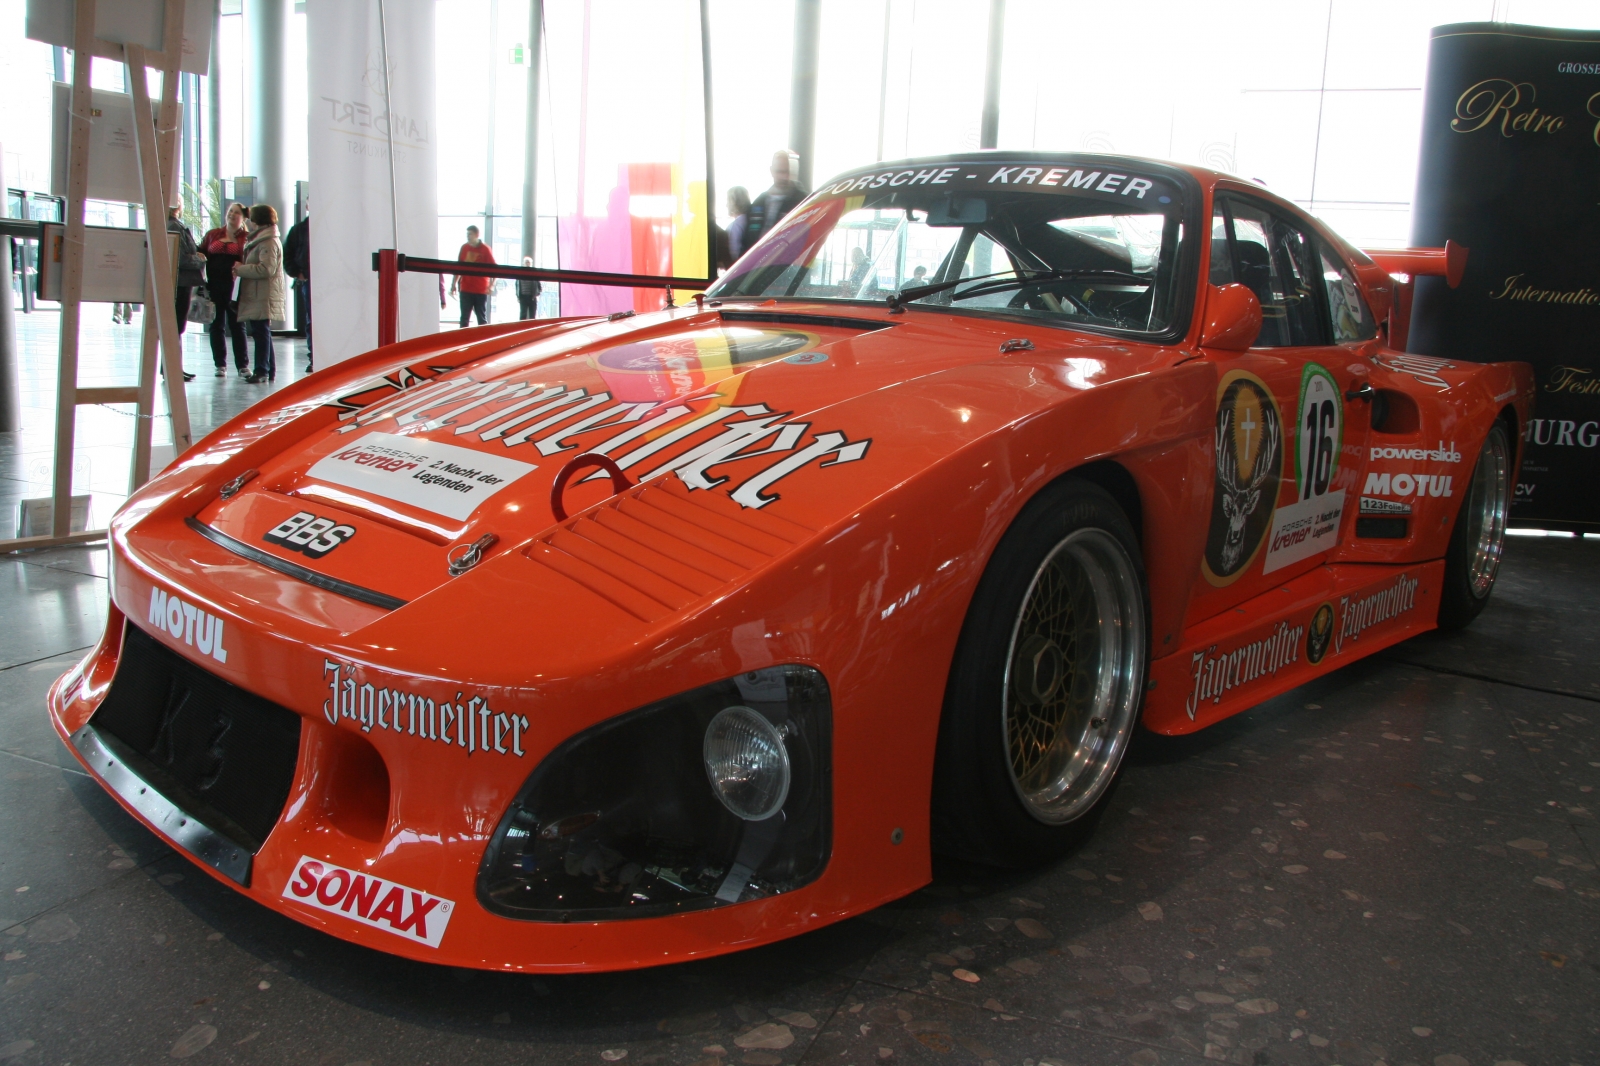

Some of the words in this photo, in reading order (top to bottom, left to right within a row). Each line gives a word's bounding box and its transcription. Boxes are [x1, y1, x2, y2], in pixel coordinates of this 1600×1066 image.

[1450, 78, 1567, 138] Retro
[821, 167, 960, 195] PORSCHE
[988, 166, 1153, 199] KREMER
[1489, 273, 1600, 306] Internatio
[331, 446, 419, 473] kremer
[363, 445, 429, 463] PORSCHE
[1303, 399, 1335, 500] 16
[1370, 440, 1462, 463] powerslide
[412, 470, 474, 494] Legenden
[428, 460, 443, 470] 2.
[443, 462, 480, 479] Nacht
[479, 473, 504, 487] der
[1363, 472, 1453, 498] MOTUL
[263, 511, 357, 559] BBS
[1281, 516, 1313, 533] PORSCHE
[1270, 526, 1312, 554] kremer
[149, 586, 228, 664] MOTUL
[323, 658, 530, 758] Jägermeister
[290, 860, 441, 940] SONAX
